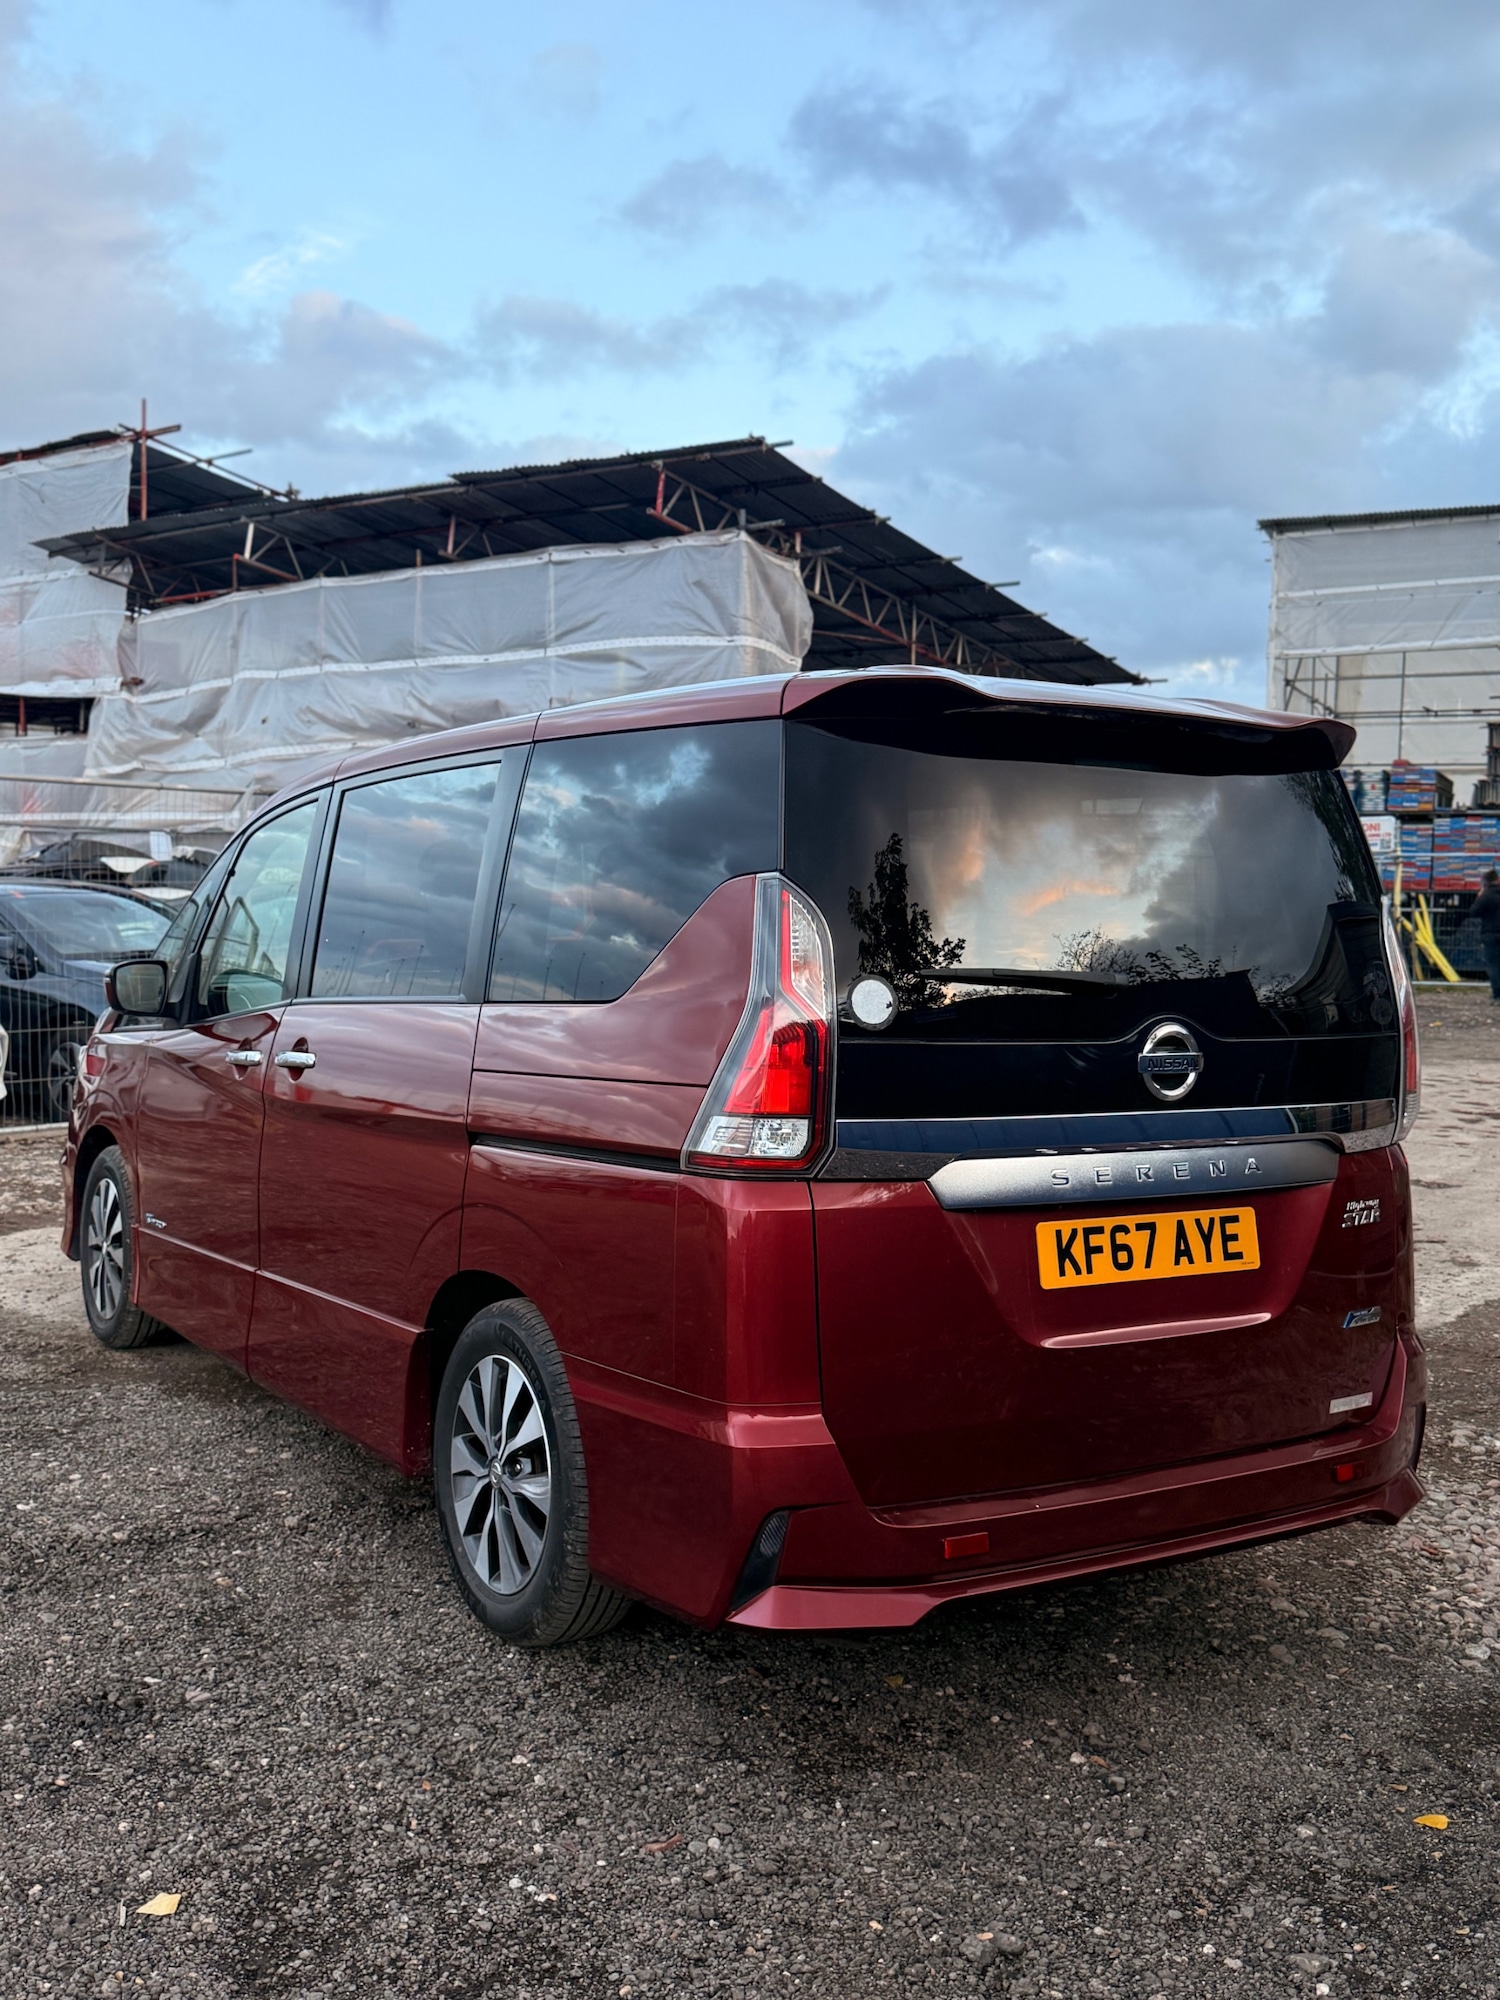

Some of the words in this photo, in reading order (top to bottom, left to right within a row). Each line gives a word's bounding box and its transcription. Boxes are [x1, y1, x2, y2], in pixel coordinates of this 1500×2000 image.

[1147, 1058, 1200, 1071] NISSAN
[1051, 1158, 1263, 1186] SERENA
[1341, 1208, 1381, 1228] STAR
[1055, 1222, 1157, 1278] KF67
[1173, 1215, 1244, 1267] AYE
